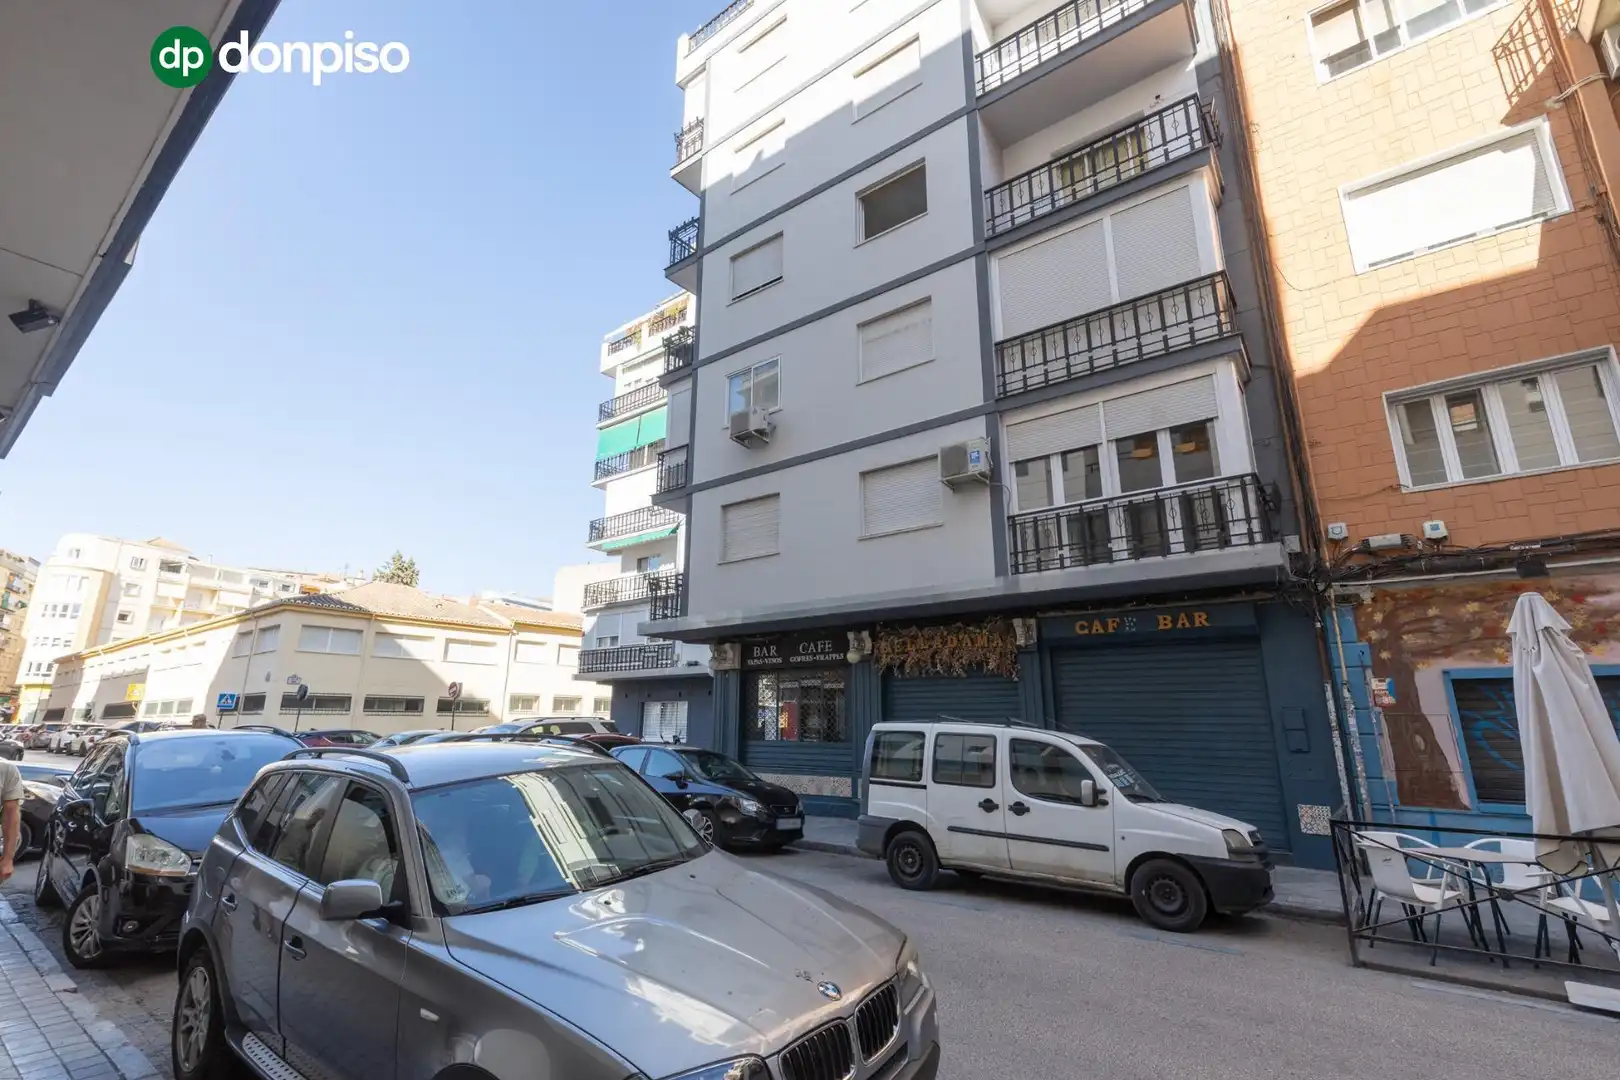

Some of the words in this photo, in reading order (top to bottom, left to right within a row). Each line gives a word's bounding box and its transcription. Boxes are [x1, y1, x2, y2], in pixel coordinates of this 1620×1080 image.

[1156, 611, 1211, 630] BAR
[753, 644, 778, 658] BAR
[799, 640, 833, 654] CAFE
